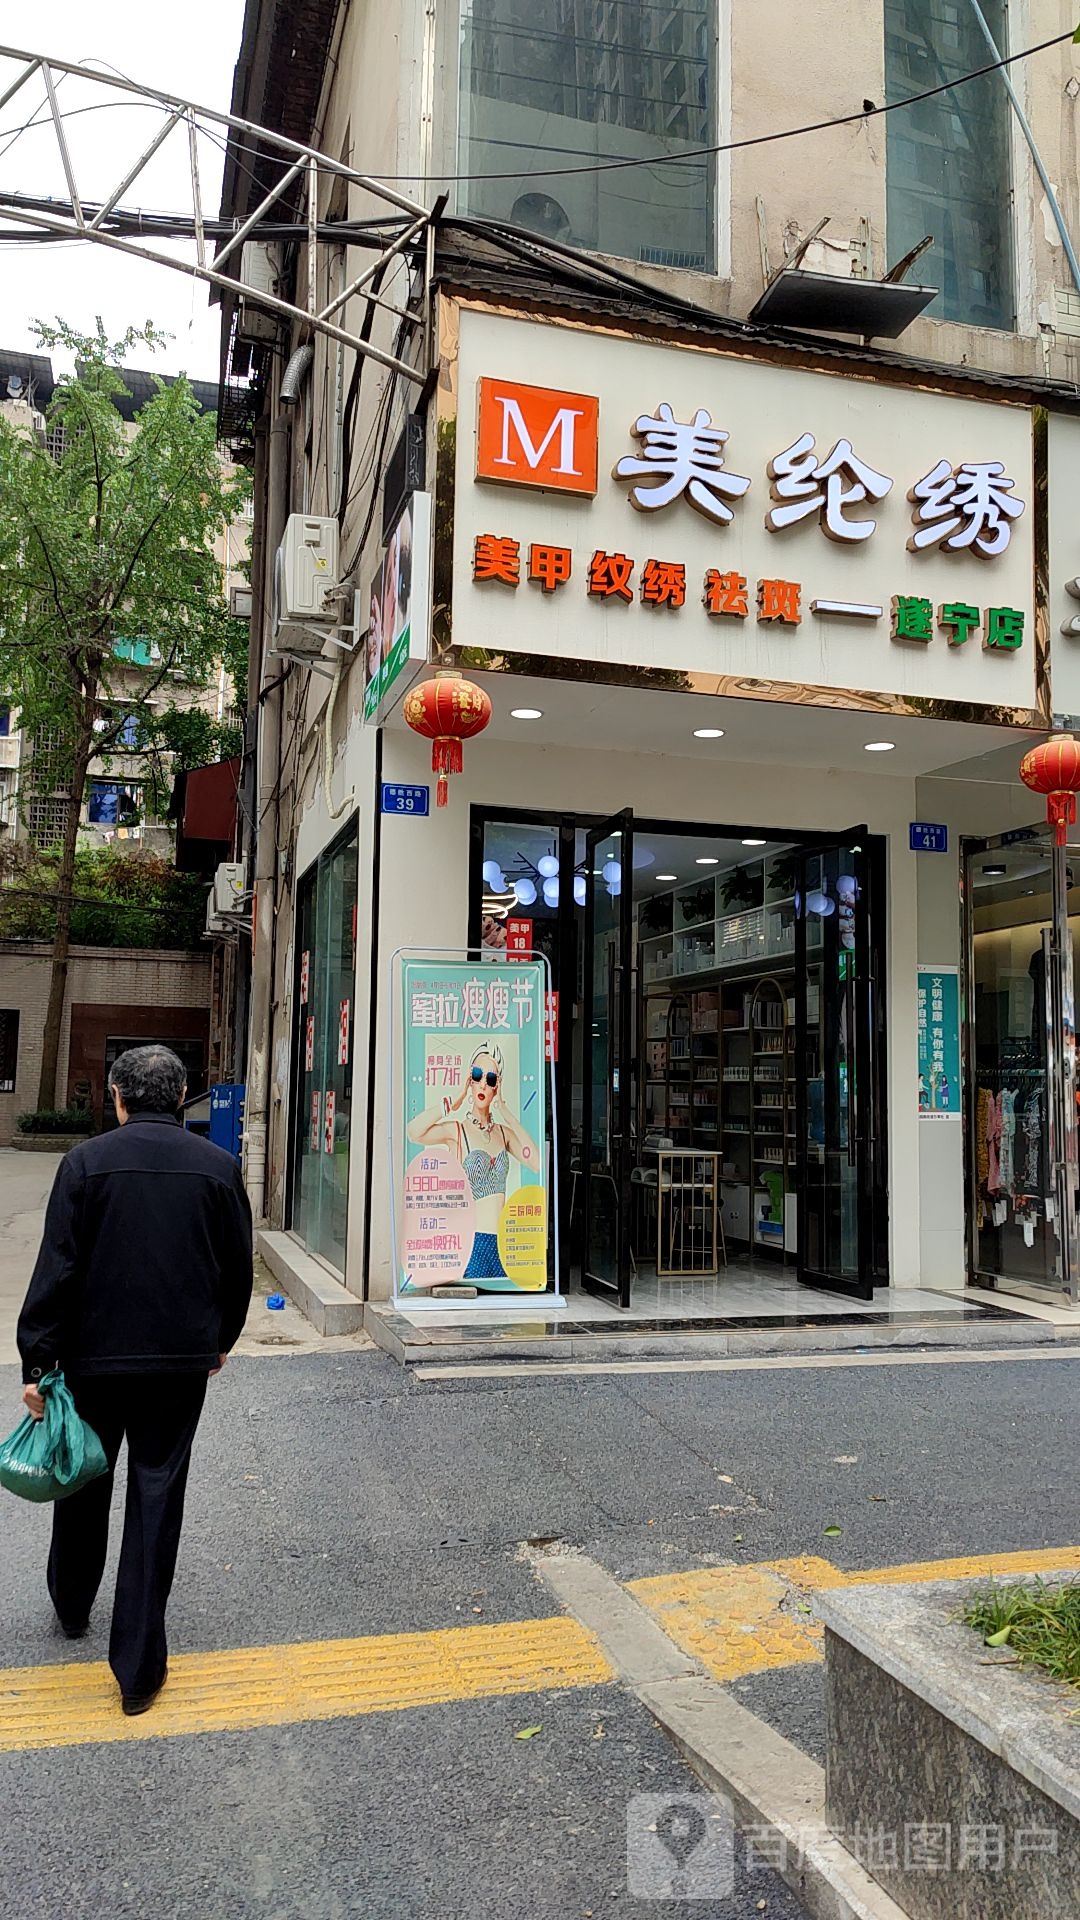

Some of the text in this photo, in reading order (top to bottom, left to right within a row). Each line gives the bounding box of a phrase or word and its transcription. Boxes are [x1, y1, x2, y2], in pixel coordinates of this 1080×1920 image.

[494, 397, 584, 477] M
[613, 403, 1025, 561] 美纶绣
[474, 534, 572, 592] 美甲
[589, 551, 686, 608] 纹绣
[704, 569, 802, 626] 祛斑
[891, 595, 1025, 651] 遂宁店
[396, 798, 414, 811] 39
[922, 834, 936, 848] 41
[513, 937, 526, 949] 18
[931, 977, 943, 1022] 文明健康
[425, 1067, 461, 1086] 打7折
[420, 1158, 448, 1170] 活动一
[419, 1217, 447, 1230] 活动二
